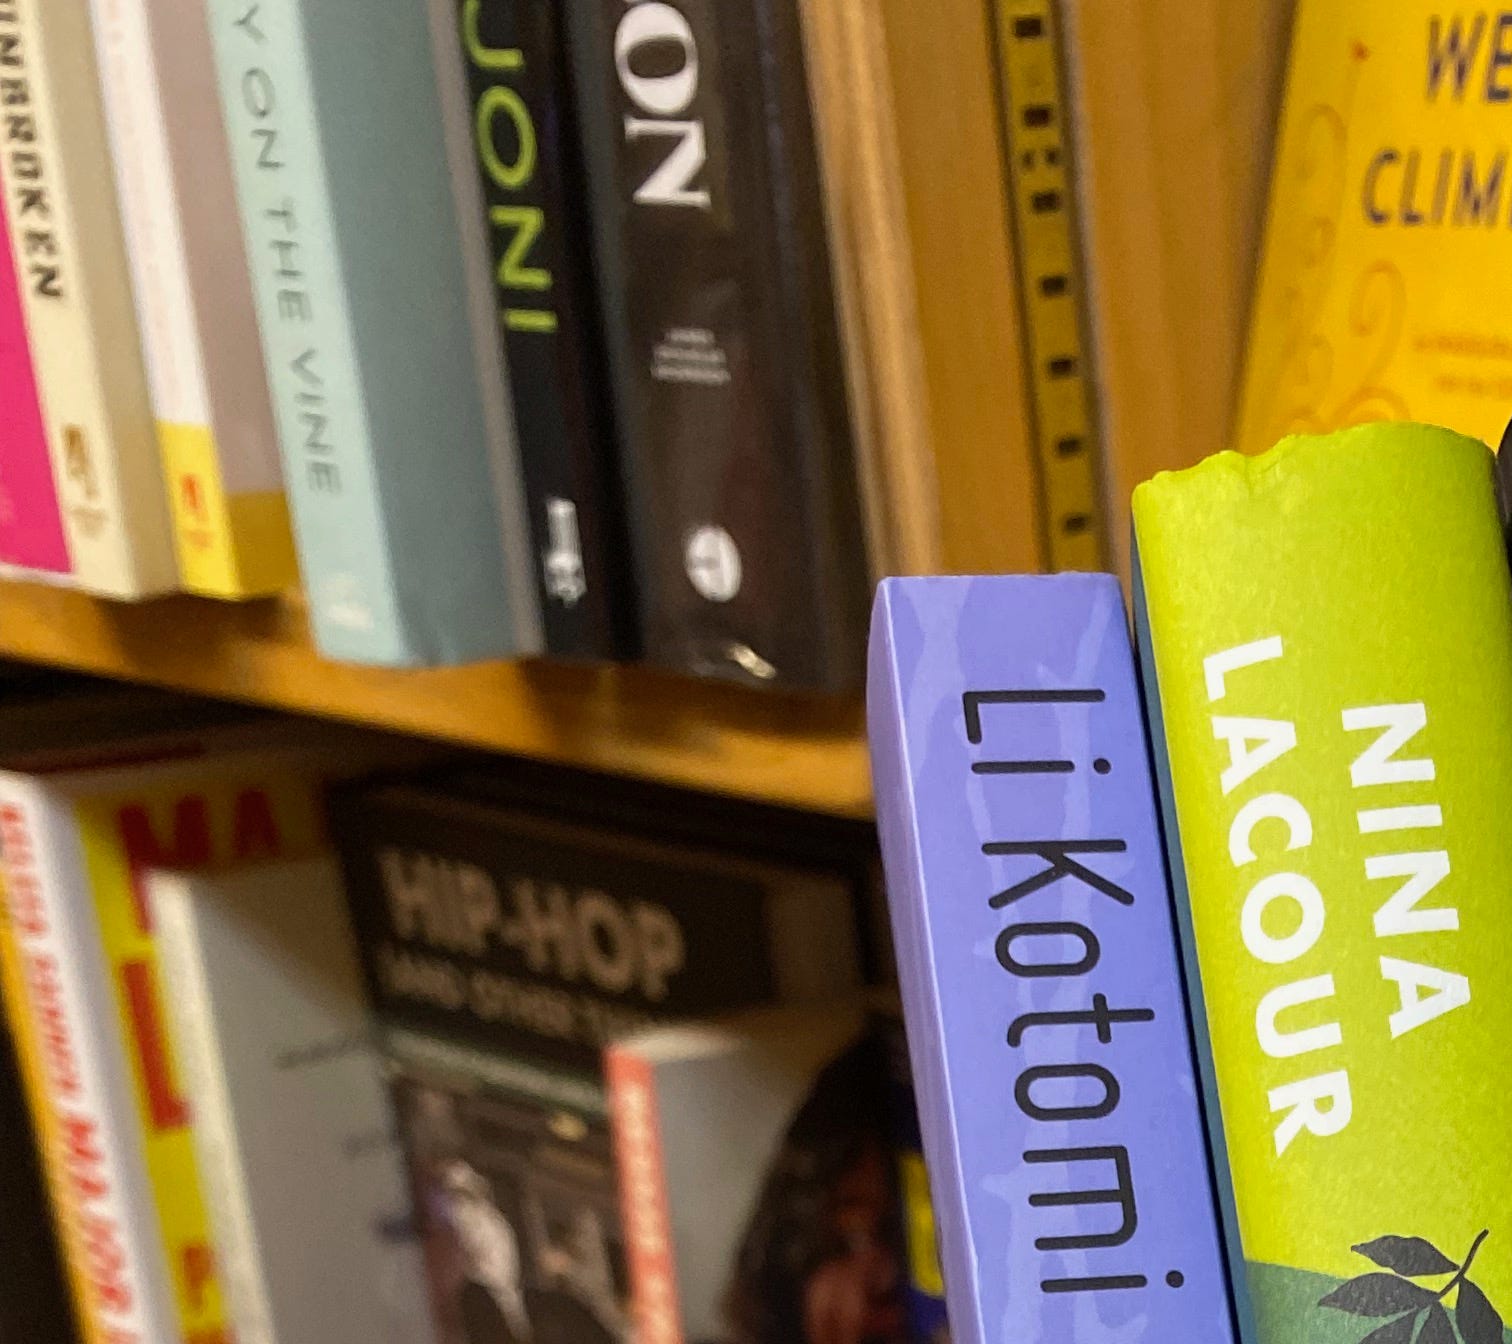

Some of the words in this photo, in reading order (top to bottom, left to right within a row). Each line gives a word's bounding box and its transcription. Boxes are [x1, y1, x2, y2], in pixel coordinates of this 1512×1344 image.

[241, 66, 286, 173] ON
[613, 2, 712, 209] ON
[261, 202, 311, 325] THE
[287, 350, 343, 498] VINE
[961, 689, 1112, 774] Li
[1202, 635, 1353, 1159] LACOUR
[1341, 701, 1471, 1041] NINA
[980, 838, 1186, 1295] Kotomi
